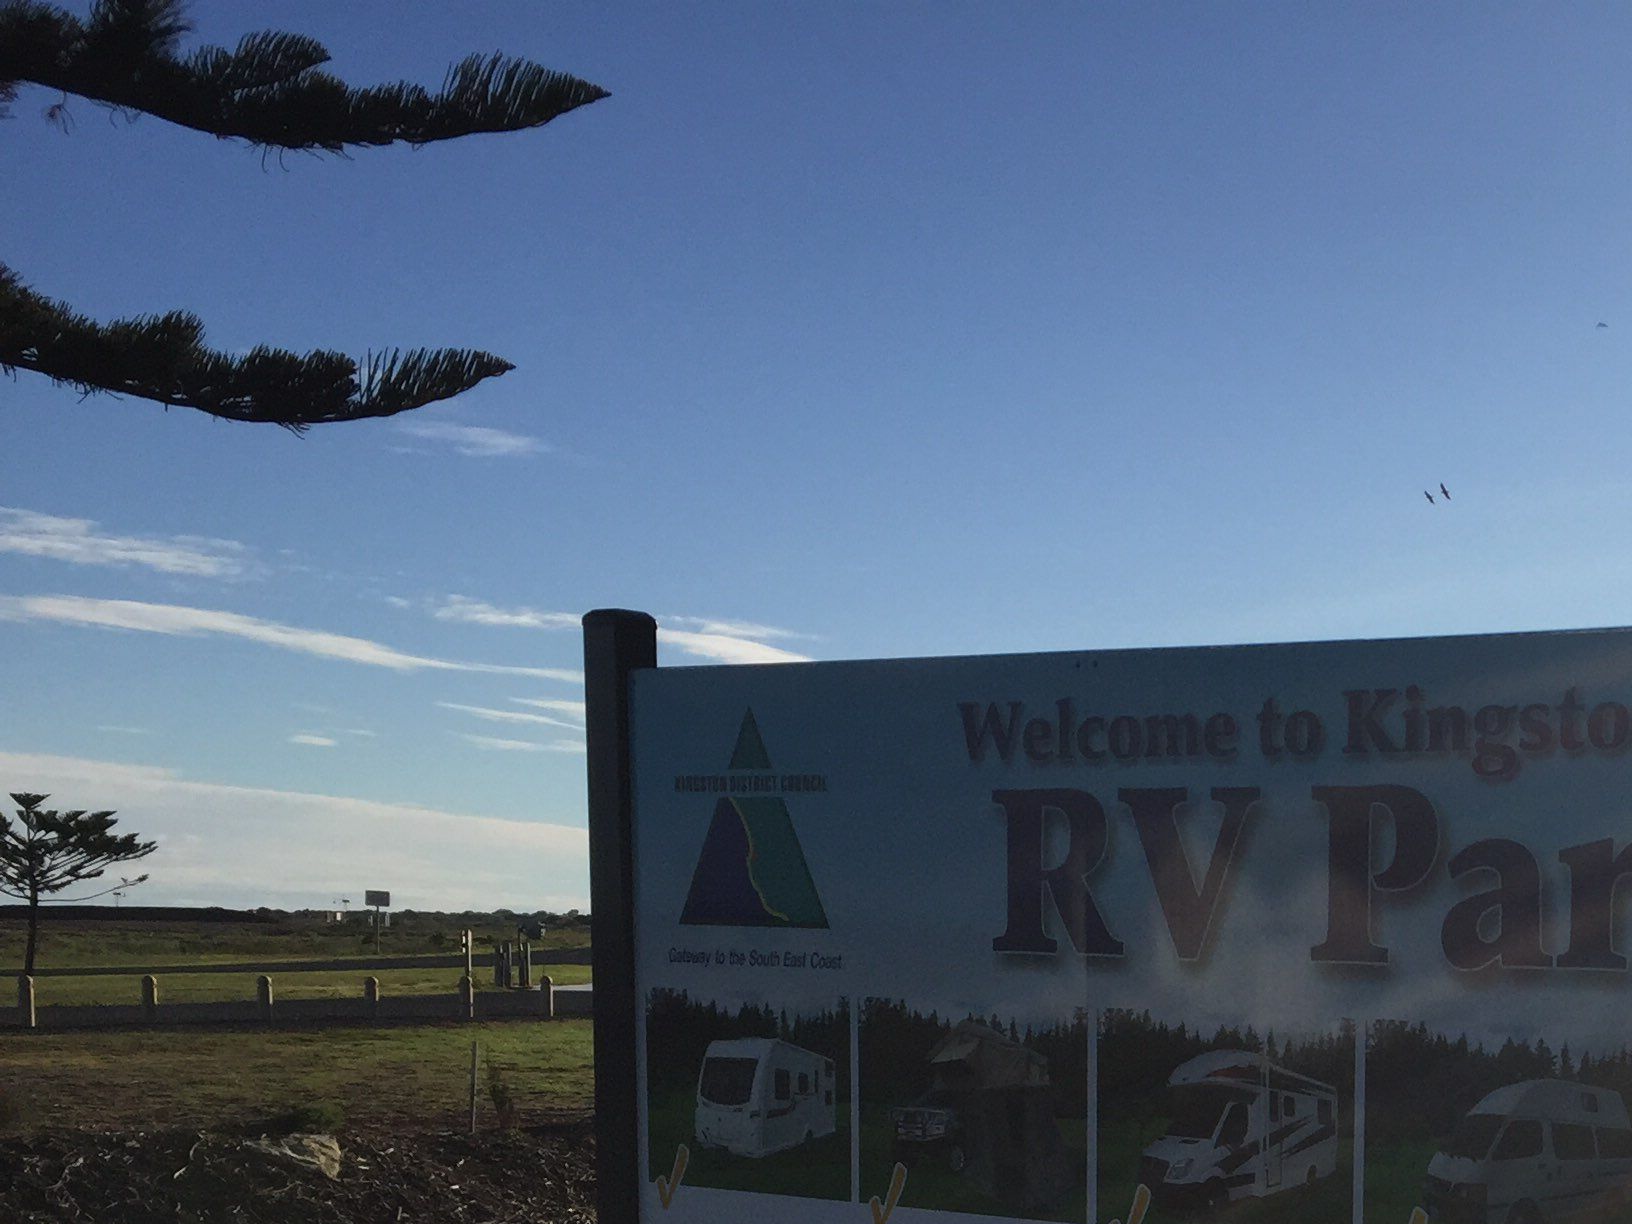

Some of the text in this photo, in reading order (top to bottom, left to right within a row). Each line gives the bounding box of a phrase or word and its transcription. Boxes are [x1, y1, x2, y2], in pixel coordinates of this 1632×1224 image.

[957, 698, 1238, 761] Welcome
[1257, 698, 1324, 757] to
[992, 786, 1261, 960] RV
[668, 948, 842, 969] Gateway to the South East Coast
